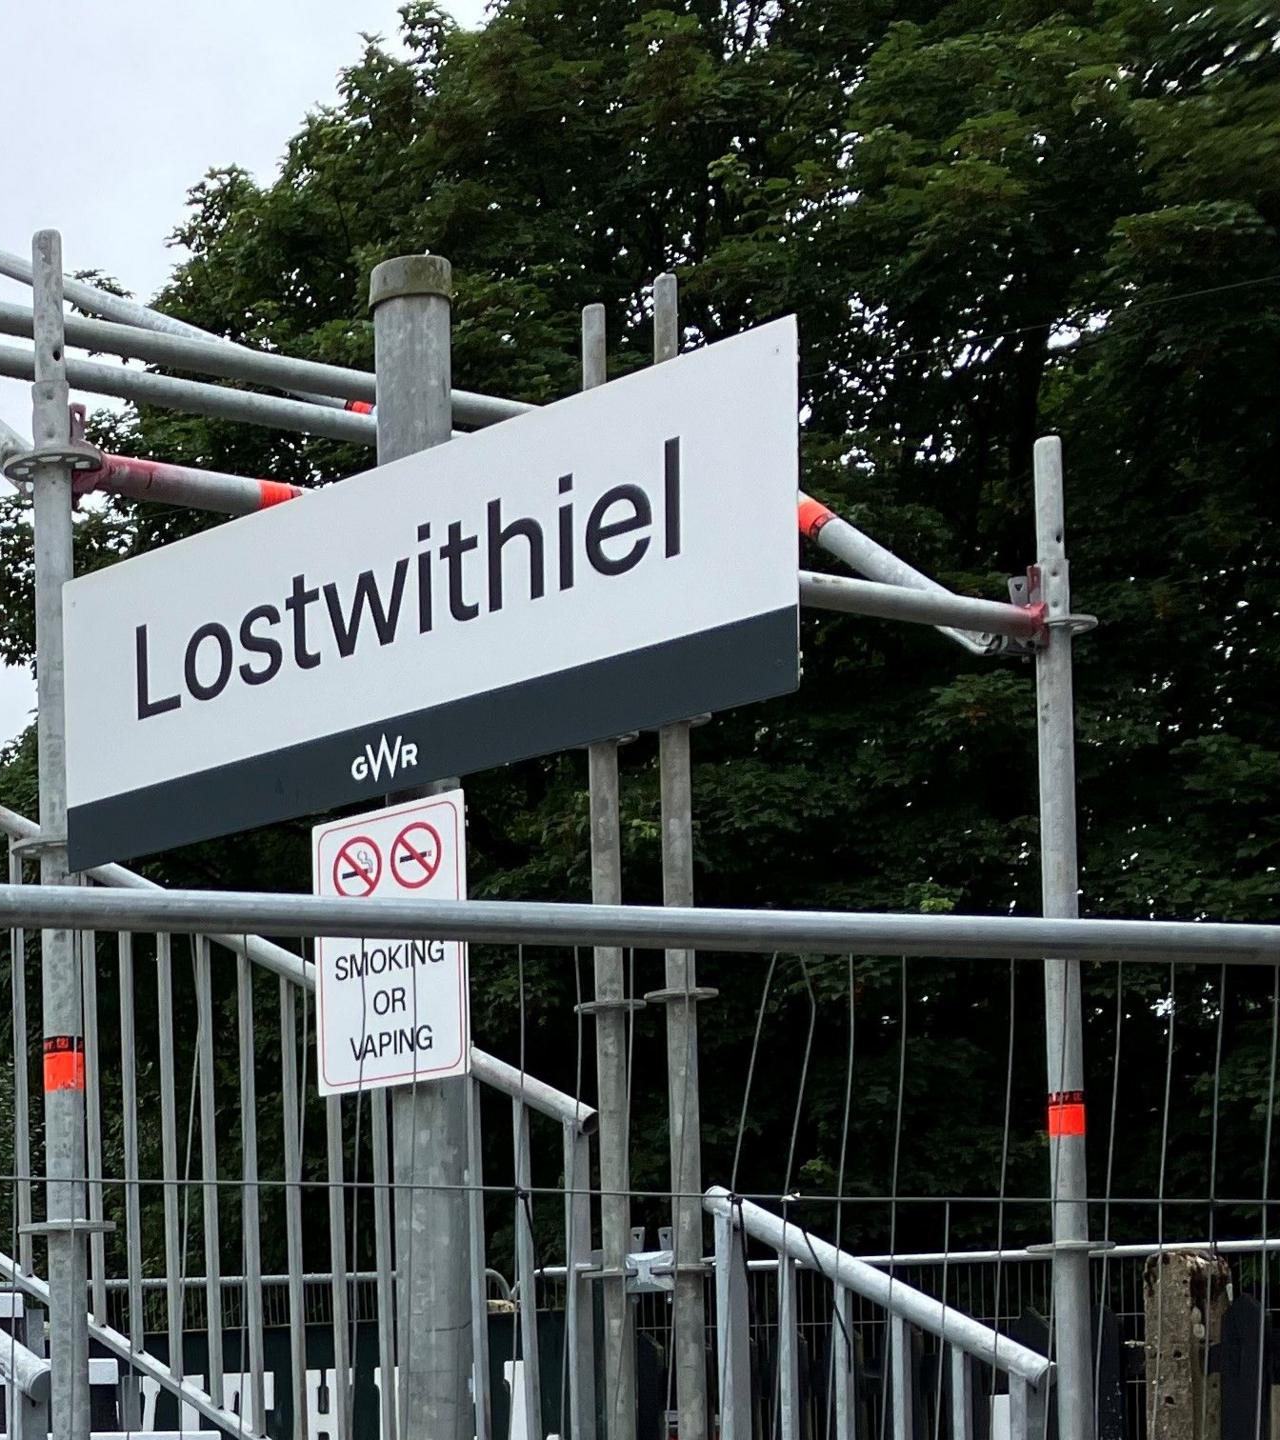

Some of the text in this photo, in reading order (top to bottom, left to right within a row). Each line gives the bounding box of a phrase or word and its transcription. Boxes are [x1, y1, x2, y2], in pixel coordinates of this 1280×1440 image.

[134, 436, 681, 721] Lostwithiel
[351, 732, 418, 783] GWR
[335, 939, 445, 982] SMOKING
[373, 986, 406, 1016] OR
[350, 1024, 433, 1062] VAPING
